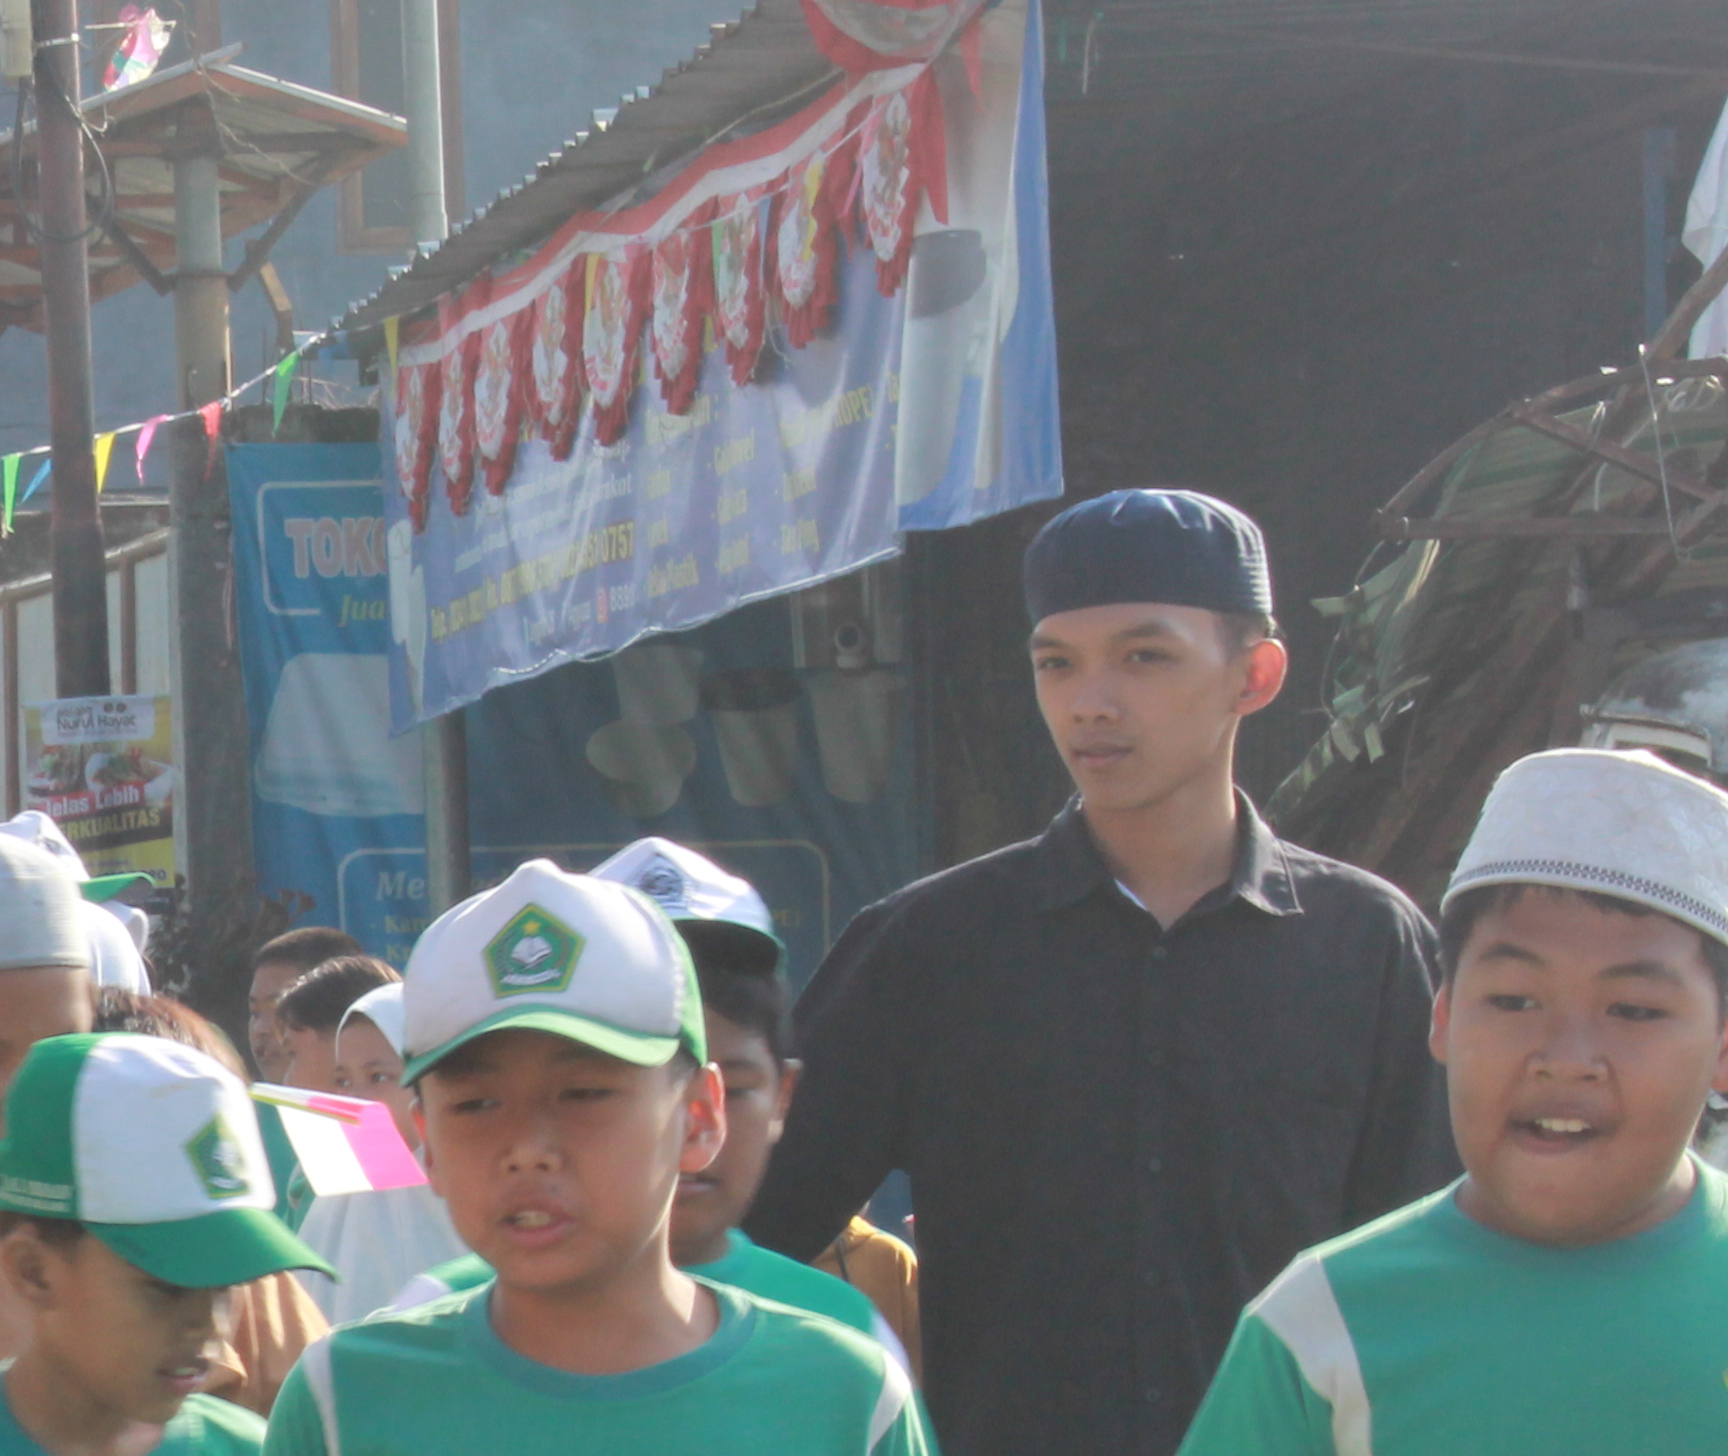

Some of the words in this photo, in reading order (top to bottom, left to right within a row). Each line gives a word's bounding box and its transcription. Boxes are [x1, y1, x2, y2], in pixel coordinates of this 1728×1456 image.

[338, 595, 386, 627] Jua
[97, 714, 136, 730] Hayat
[95, 784, 140, 810] Lebih
